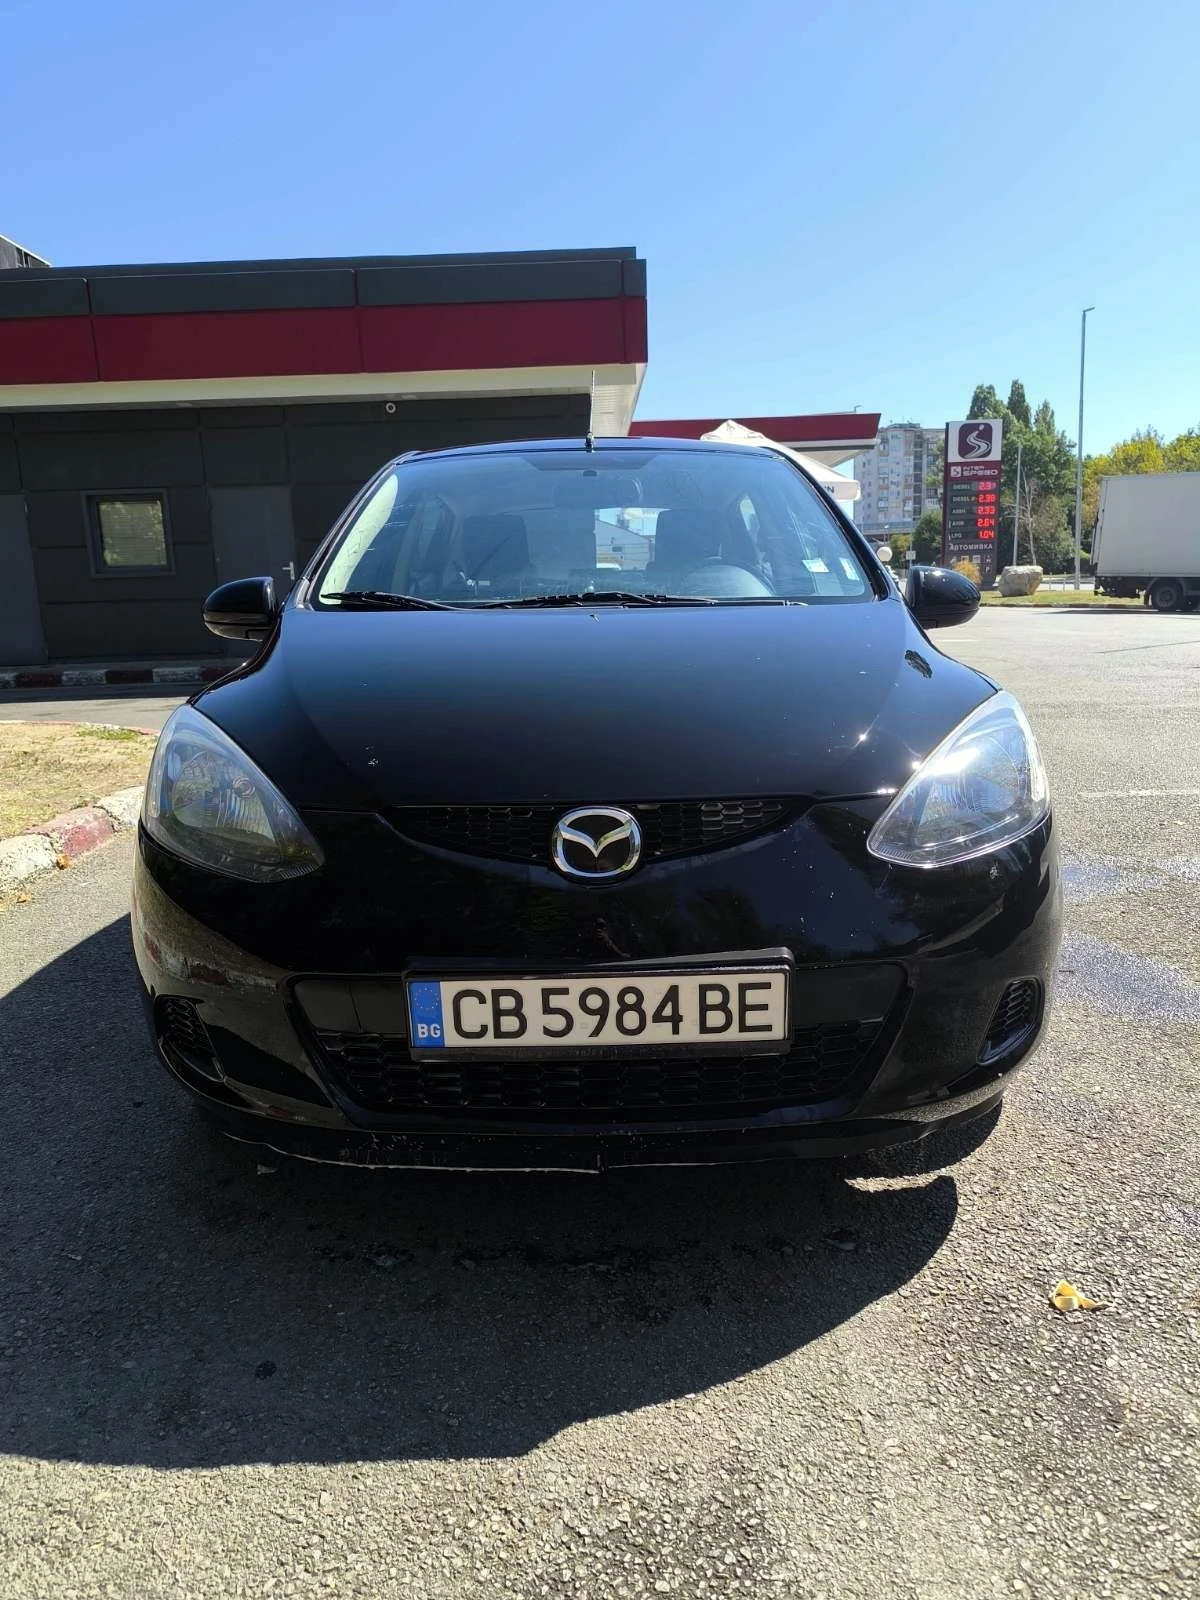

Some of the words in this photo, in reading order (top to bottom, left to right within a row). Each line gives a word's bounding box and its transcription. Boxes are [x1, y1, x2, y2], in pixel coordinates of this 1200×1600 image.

[452, 988, 528, 1040] CB
[541, 985, 684, 1038] 5984
[699, 981, 773, 1035] BE
[417, 1023, 441, 1038] BG
